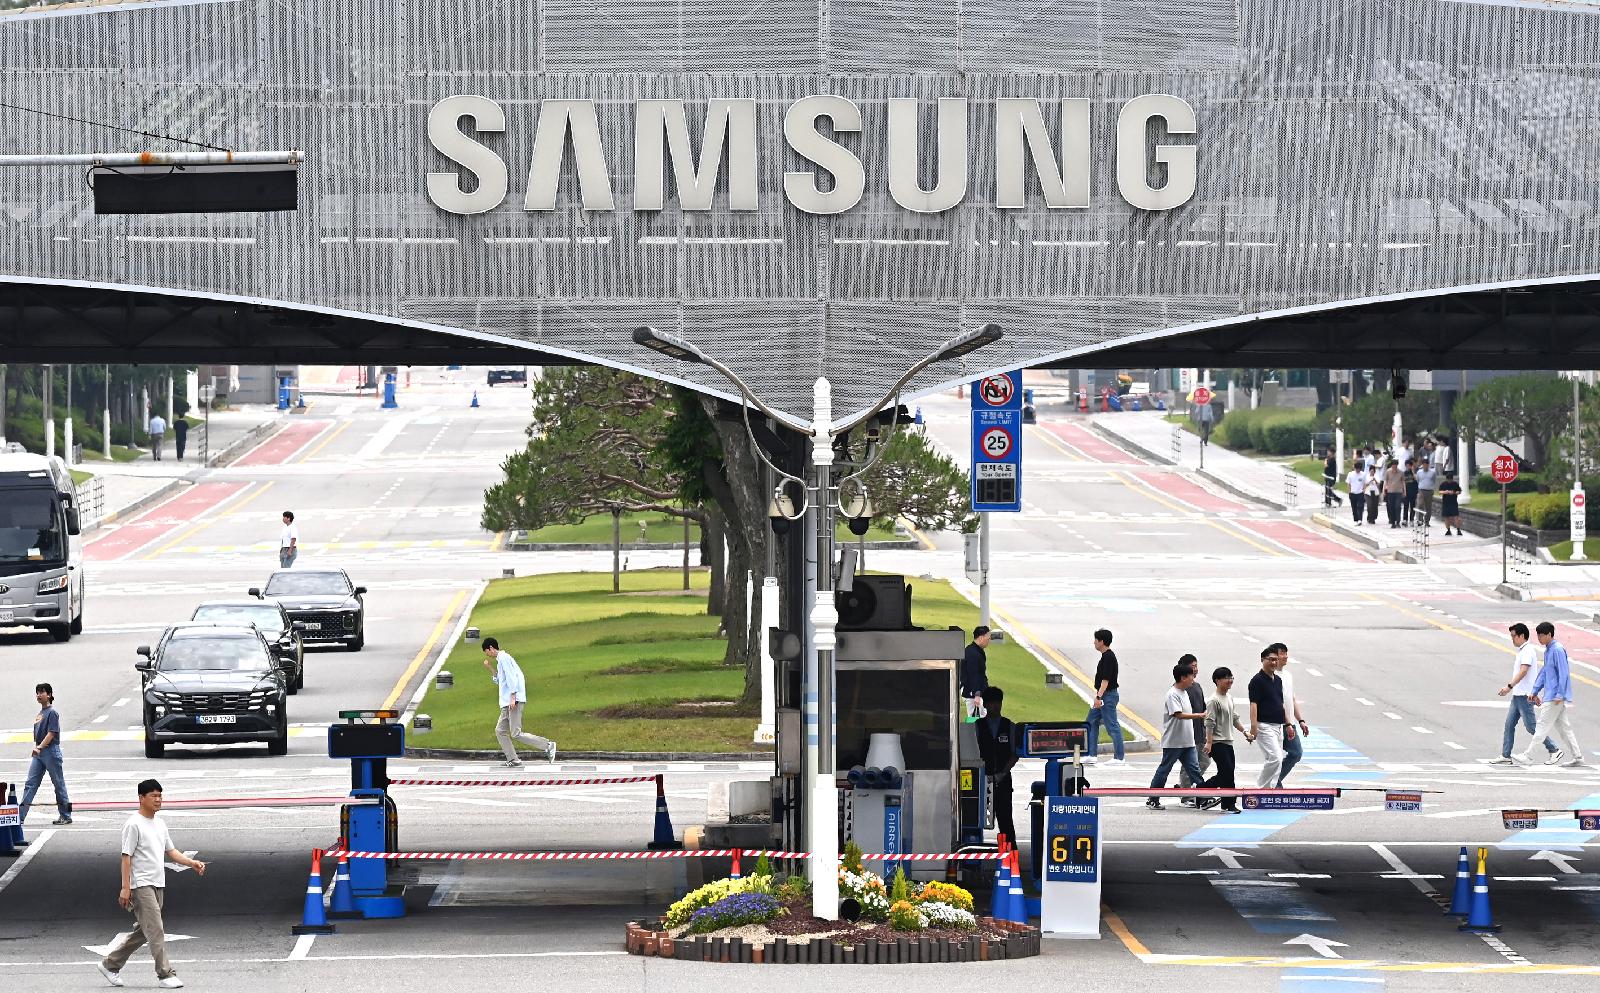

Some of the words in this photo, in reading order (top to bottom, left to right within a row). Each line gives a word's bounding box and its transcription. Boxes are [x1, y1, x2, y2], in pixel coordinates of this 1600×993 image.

[426, 94, 1198, 214] SAMSUNG
[987, 435, 1006, 450] 25
[980, 463, 1013, 472] 현재속도
[1495, 460, 1514, 470] 정지
[1495, 471, 1514, 479] STOP
[1395, 802, 1420, 811] 진입금지
[1512, 820, 1538, 829] 진입금지
[1052, 836, 1068, 862] 6
[1076, 837, 1091, 861] 7
